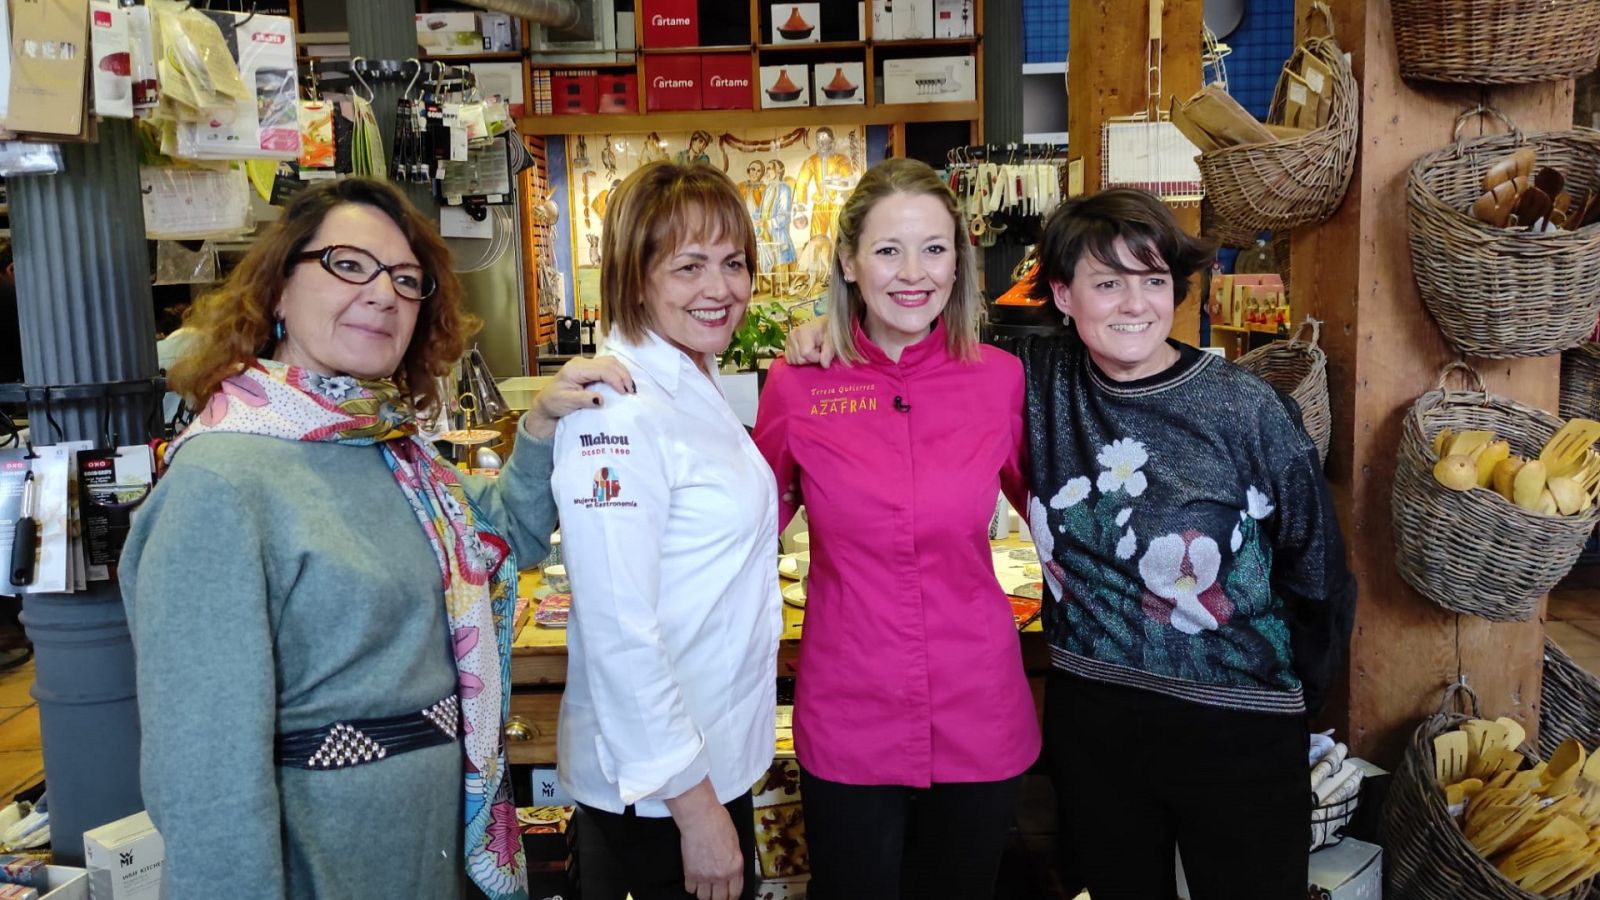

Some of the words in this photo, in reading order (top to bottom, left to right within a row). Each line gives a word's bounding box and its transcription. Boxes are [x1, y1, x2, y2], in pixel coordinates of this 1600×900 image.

[810, 388, 836, 396] Teresa
[579, 432, 629, 447] Mahou
[582, 448, 606, 456] DESDE
[574, 497, 597, 505] Mujeres
